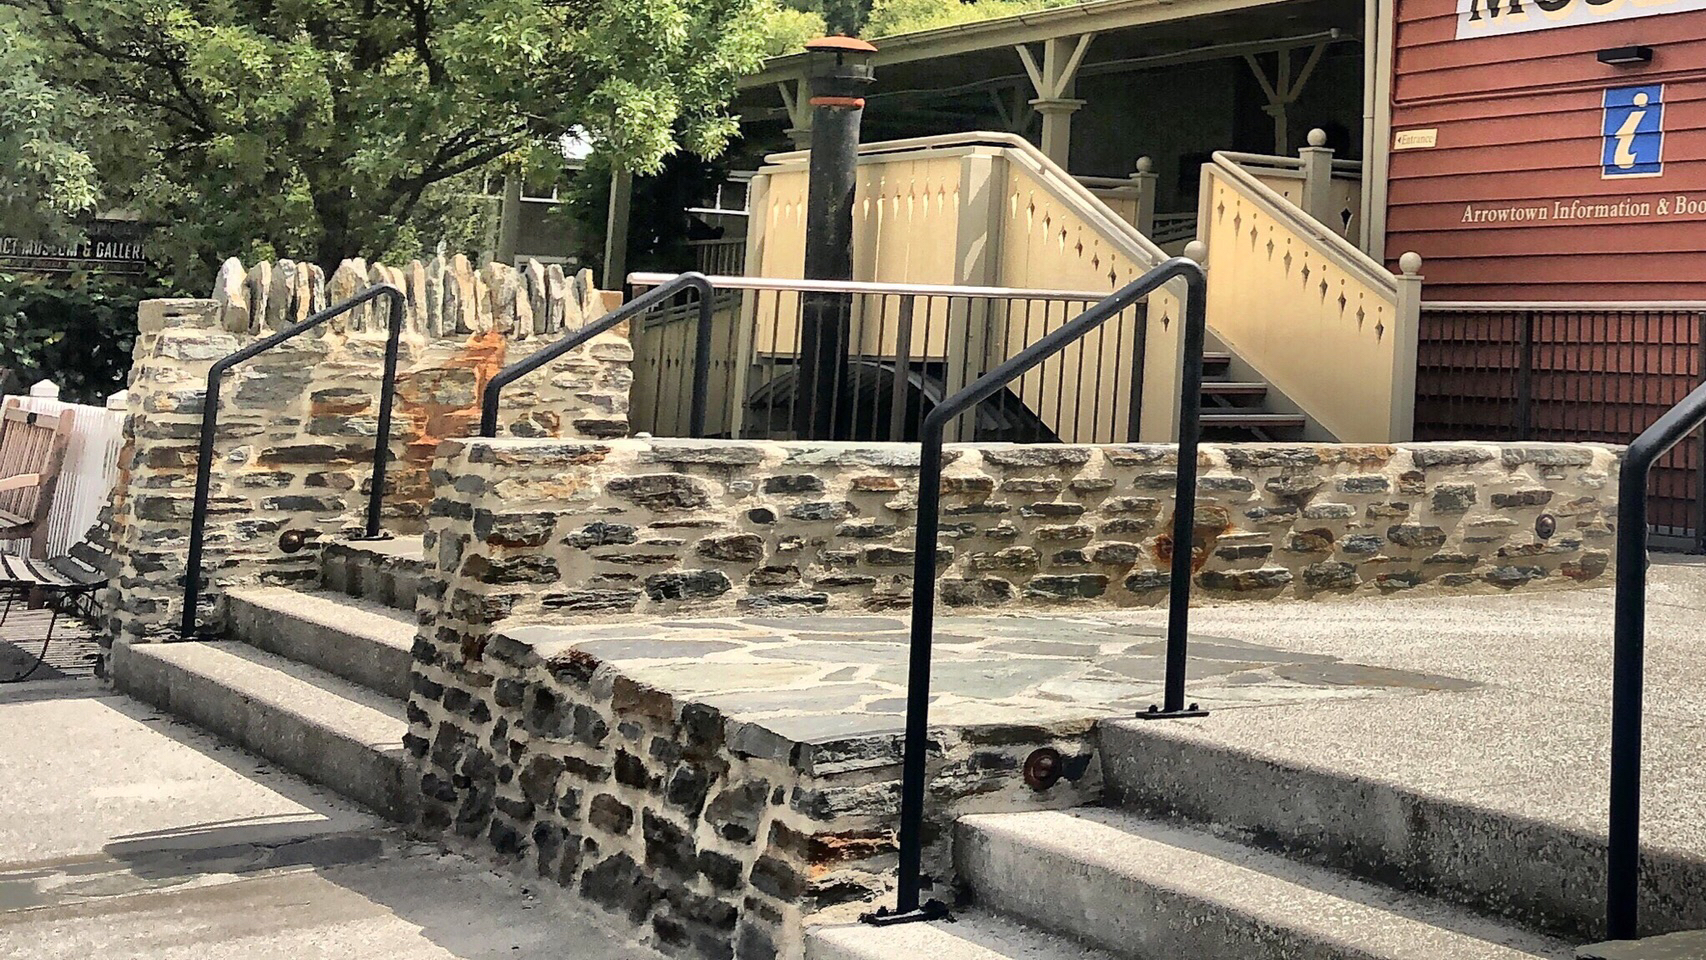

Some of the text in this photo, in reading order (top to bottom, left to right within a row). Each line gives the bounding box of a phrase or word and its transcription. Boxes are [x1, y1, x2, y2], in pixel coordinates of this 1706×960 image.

[1401, 134, 1435, 145] Entrance
[1461, 205, 1548, 223] Arrowtown
[1552, 198, 1650, 220] Information
[1656, 198, 1670, 215] &
[83, 241, 91, 257] &
